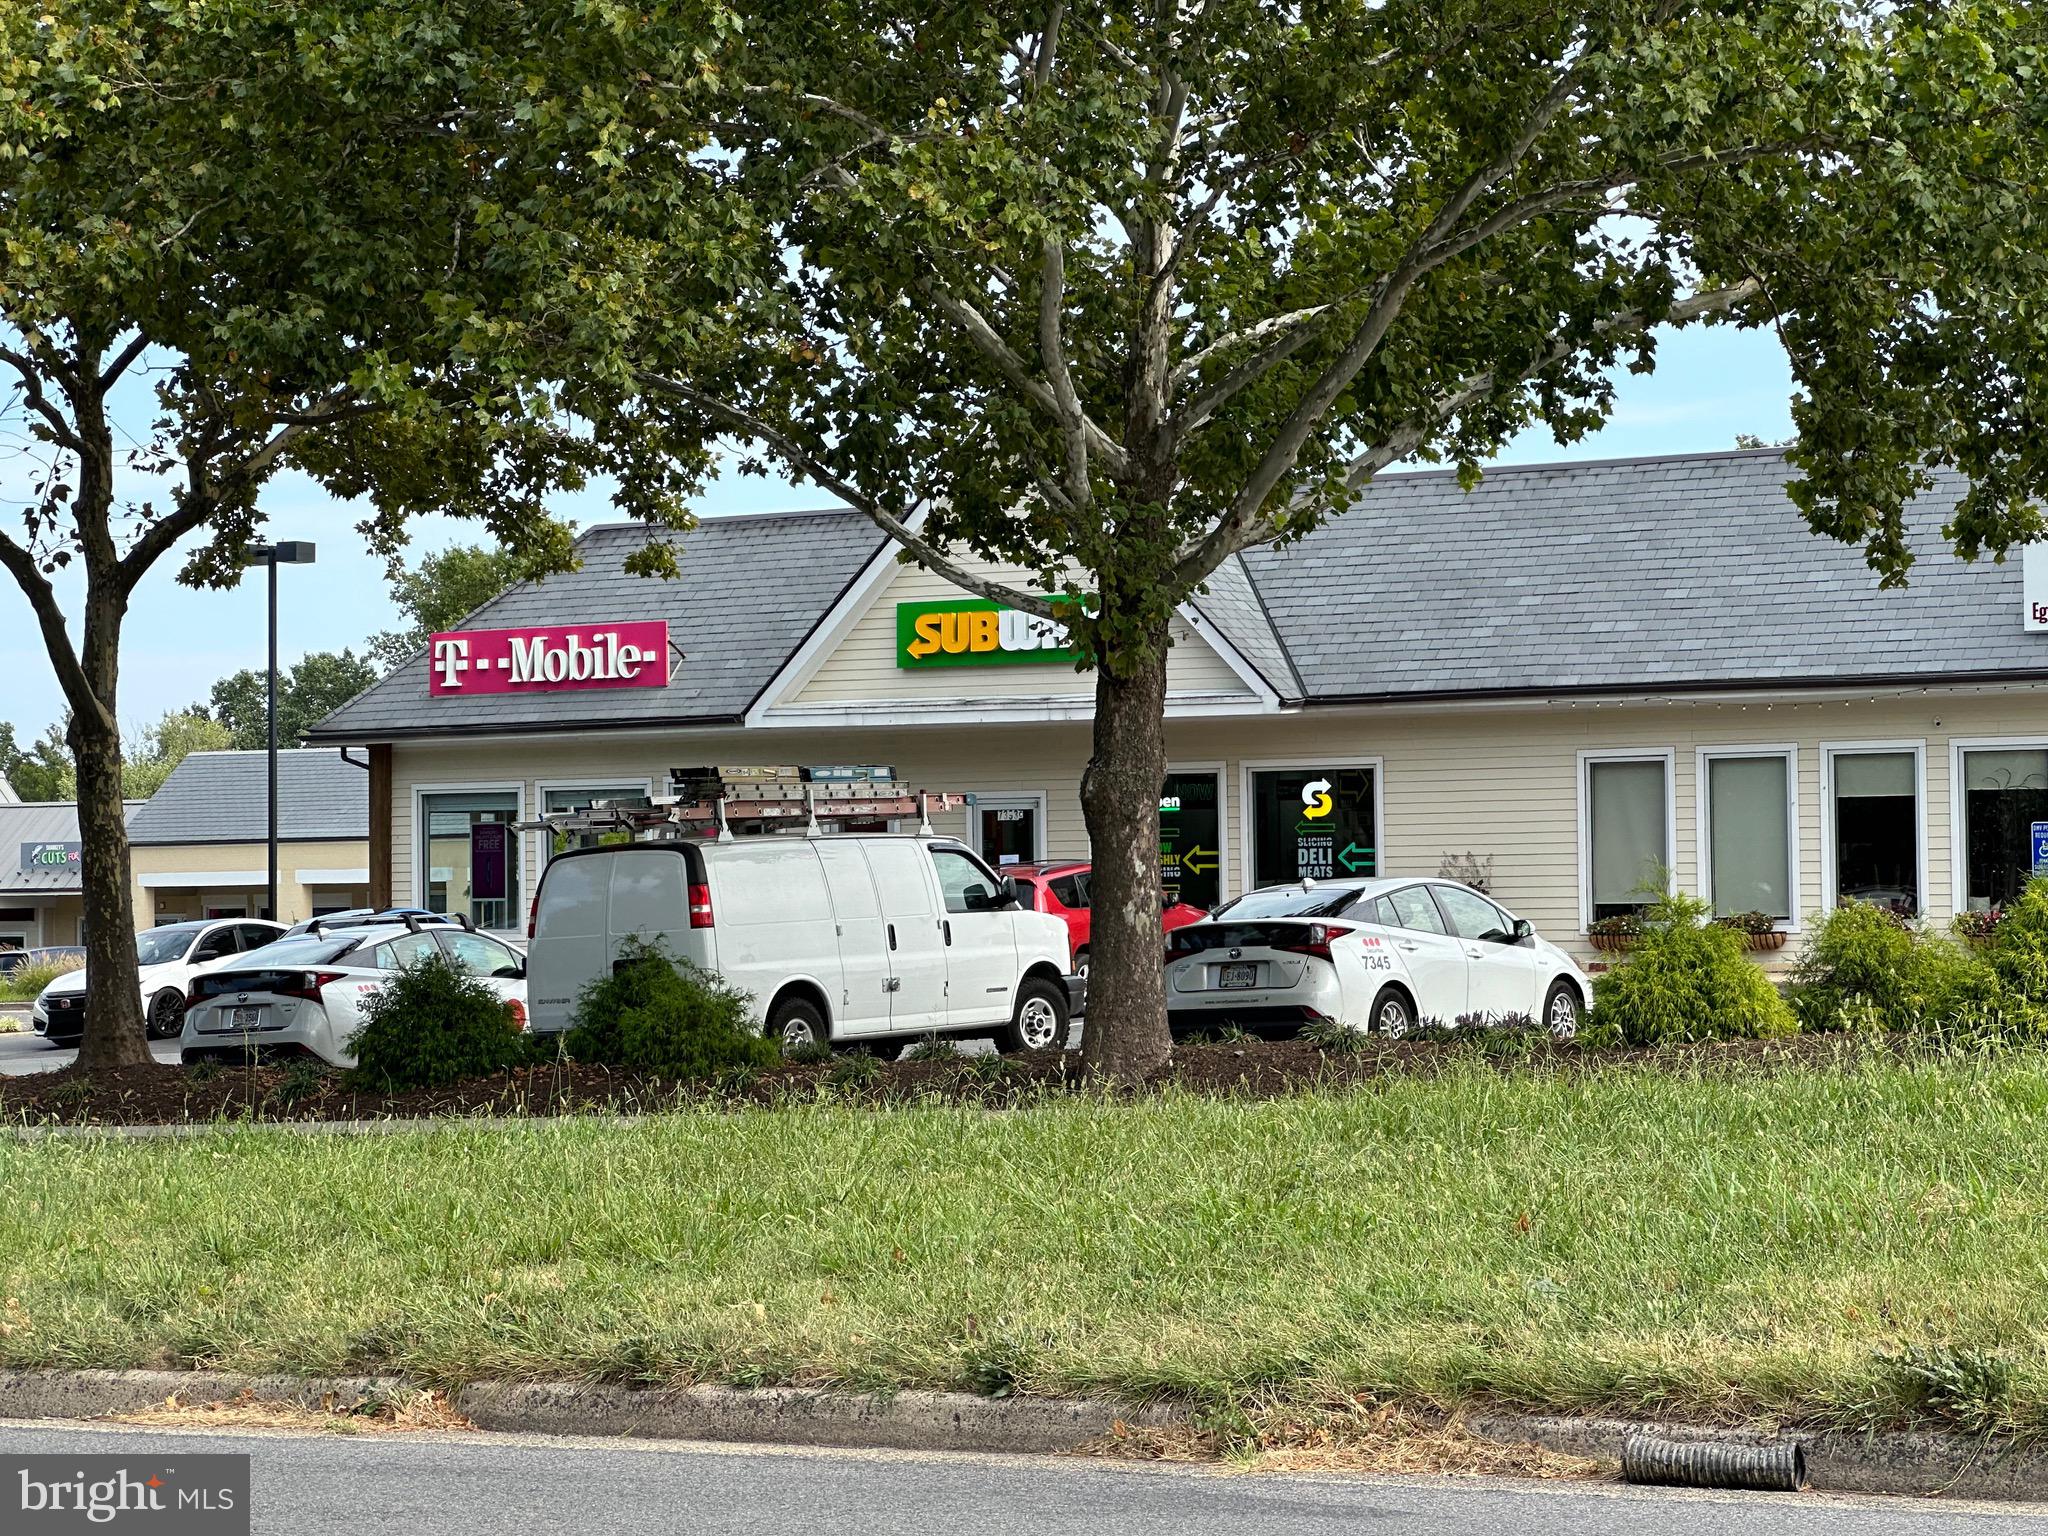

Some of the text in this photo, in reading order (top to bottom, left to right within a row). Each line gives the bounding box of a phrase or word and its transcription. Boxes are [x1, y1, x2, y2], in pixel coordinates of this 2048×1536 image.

[907, 610, 1099, 660] SUBWA
[478, 840, 500, 850] FREE
[1298, 837, 1333, 847] SLICING
[41, 851, 67, 865] CUTS
[1298, 848, 1333, 865] DELI
[1161, 866, 1181, 878] ING
[1298, 866, 1333, 878] MEATS
[1361, 955, 1391, 970] 7345
